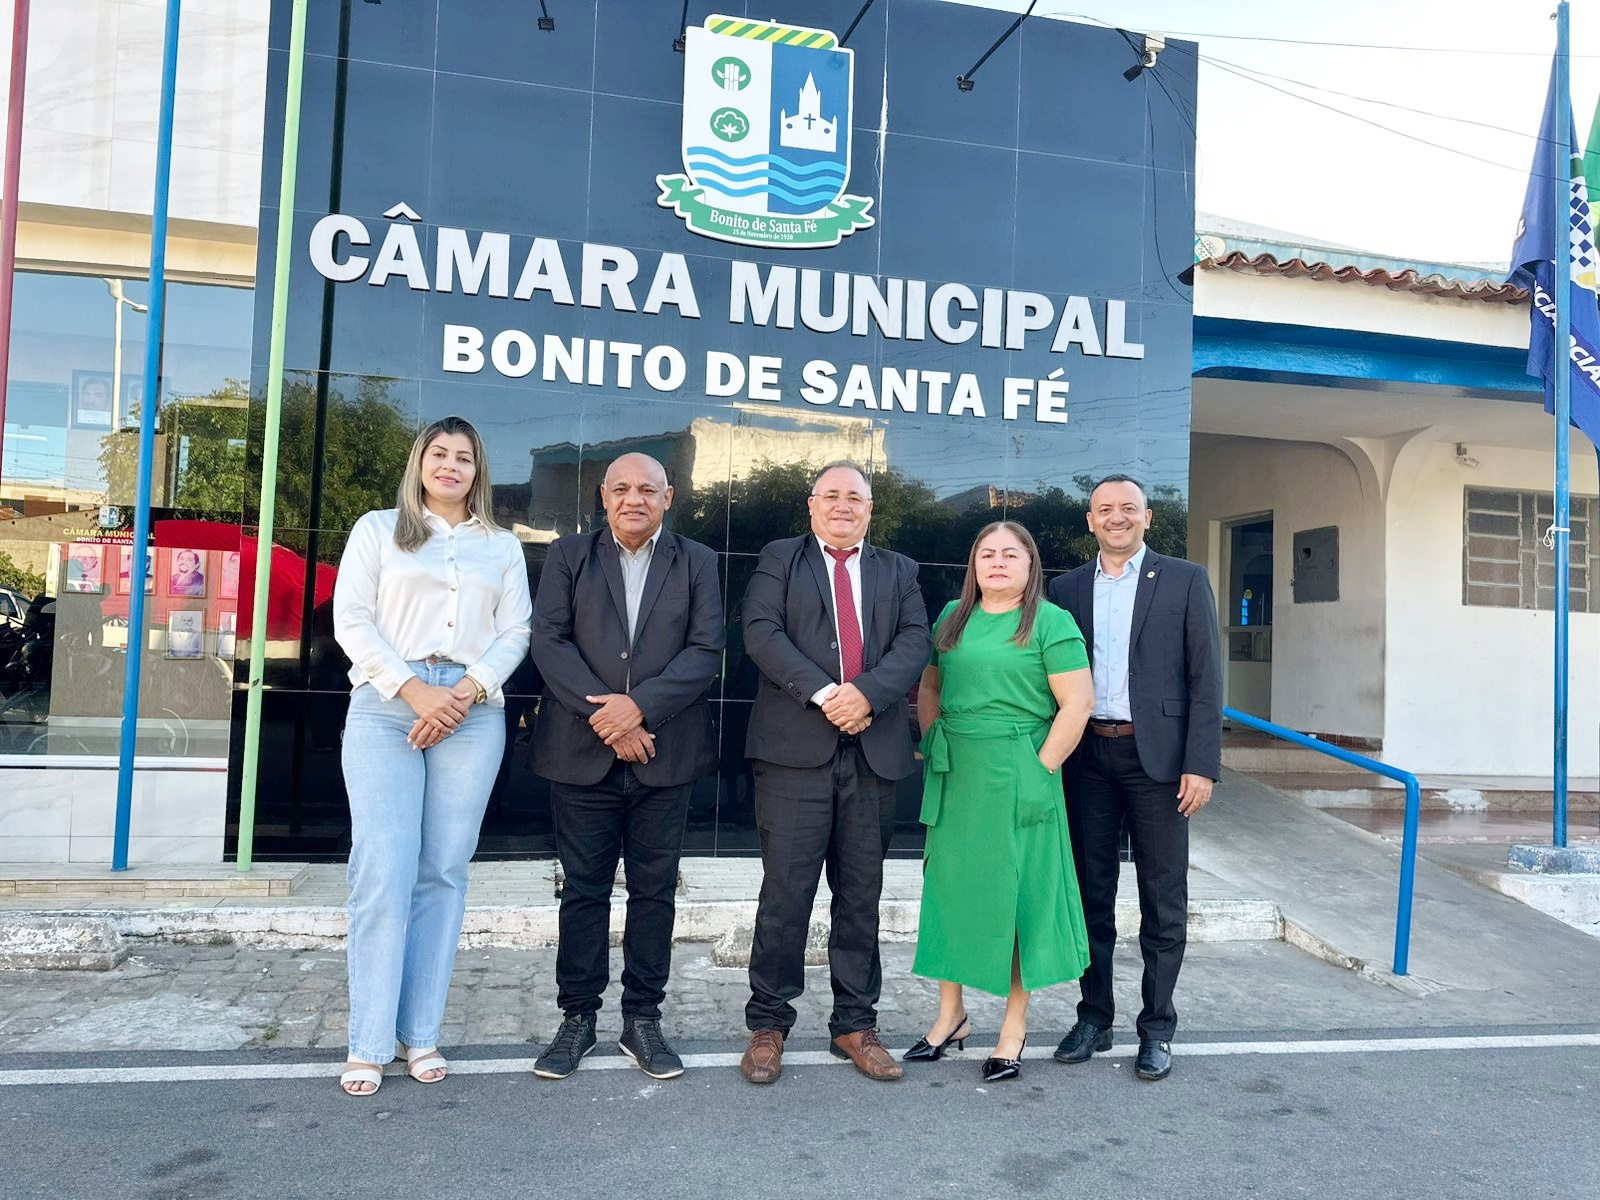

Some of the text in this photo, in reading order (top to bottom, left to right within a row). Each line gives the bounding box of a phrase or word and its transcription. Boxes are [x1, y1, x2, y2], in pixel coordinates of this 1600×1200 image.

[709, 209, 818, 234] Bonito de Santa Fé
[747, 230, 773, 239] Novembro
[773, 232, 780, 240] de
[309, 201, 1145, 360] CÂMARA MUNICIPAL
[442, 323, 1070, 424] BONITO DE SANTA FÉ
[63, 527, 103, 537] CÂMARA
